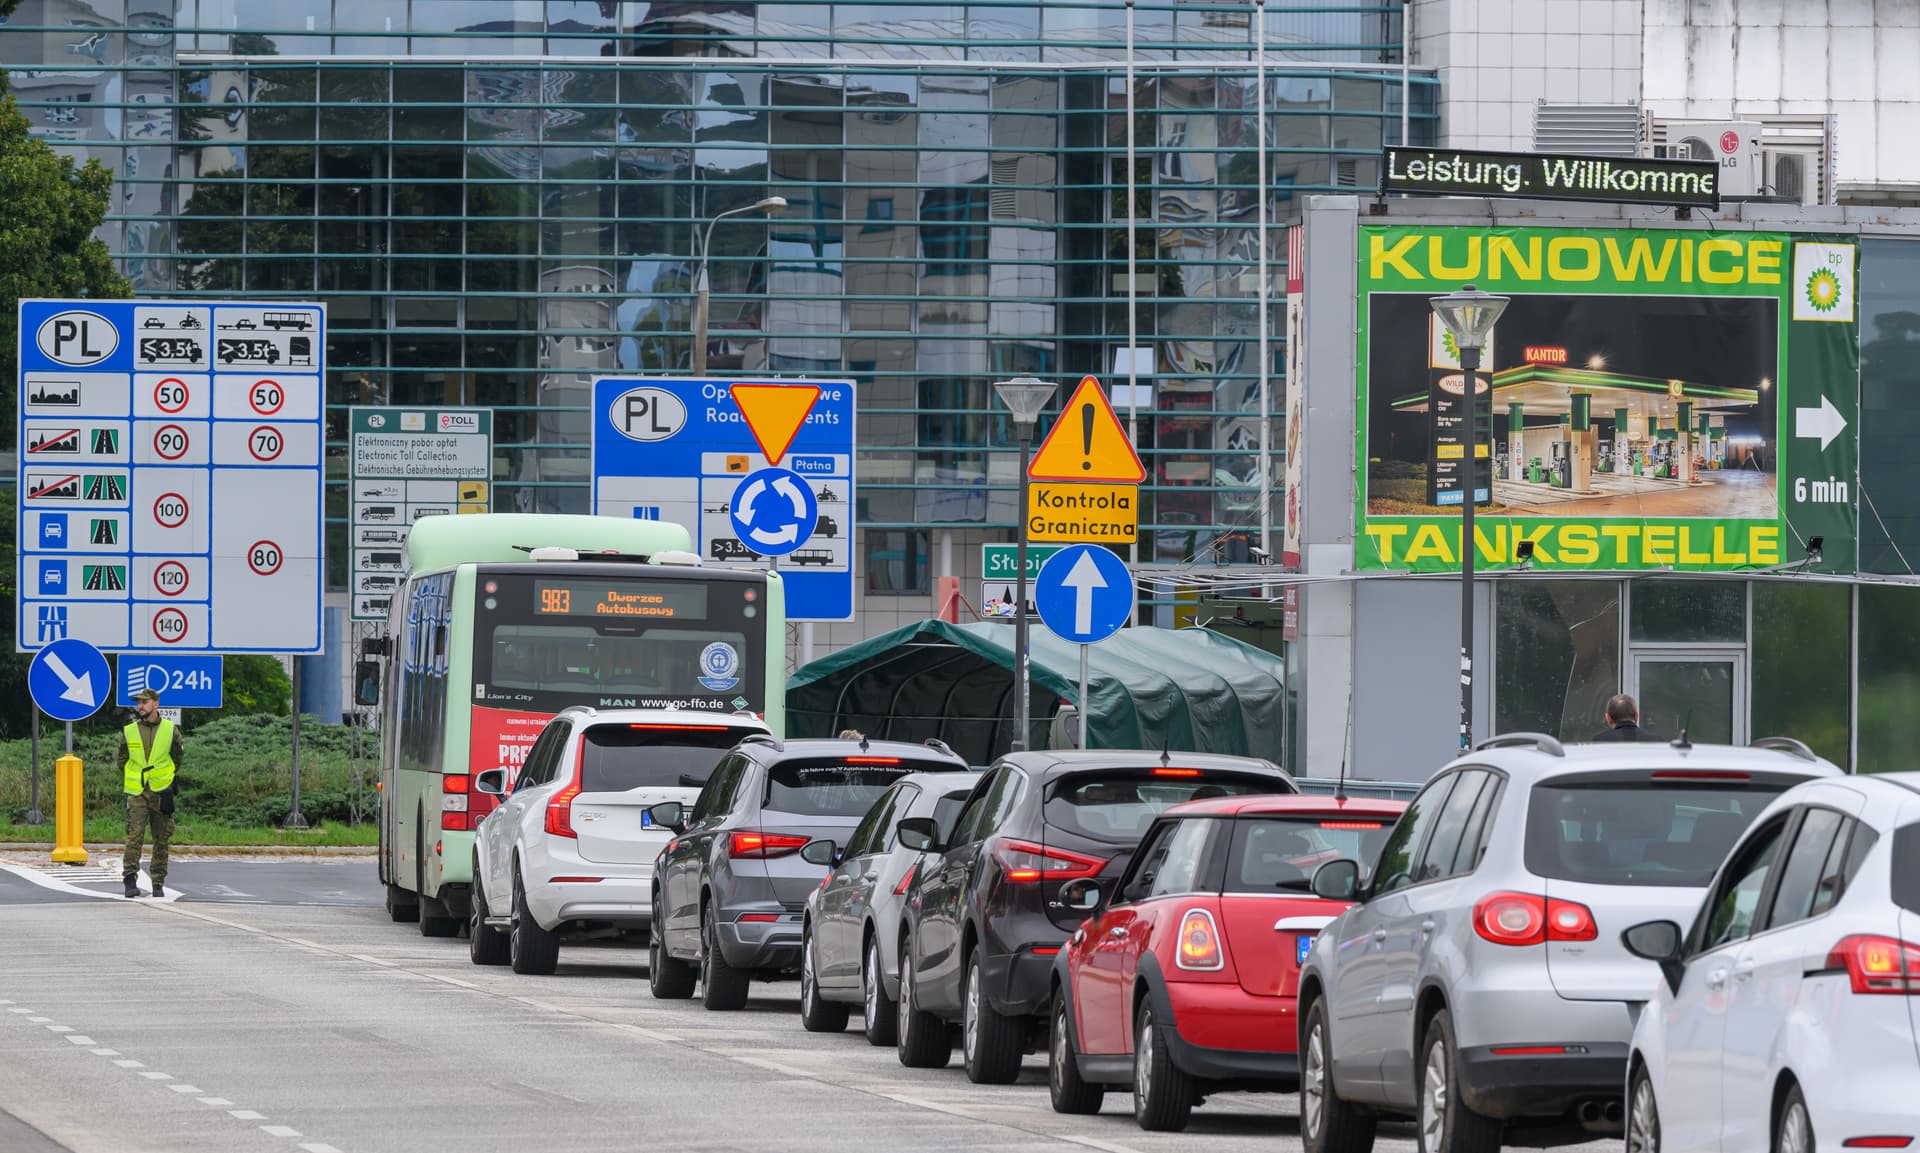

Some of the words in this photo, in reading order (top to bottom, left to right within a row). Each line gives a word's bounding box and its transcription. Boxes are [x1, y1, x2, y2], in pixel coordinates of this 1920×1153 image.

[1721, 156, 1737, 168] LG
[1388, 151, 1530, 193] Leistung.
[1368, 234, 1784, 285] KUNOWICE
[1828, 250, 1843, 266] bp
[54, 320, 102, 357] PL
[1525, 347, 1567, 362] KANTOR
[159, 387, 184, 404] 50
[255, 389, 280, 406] 50
[370, 416, 382, 426] PL
[624, 396, 672, 433] PL
[160, 434, 183, 451] 90
[256, 436, 278, 452] 70
[357, 436, 408, 449] Elektroniczny
[436, 438, 457, 450] opłat
[357, 449, 398, 461] Electronic
[400, 450, 413, 461] Toll
[416, 450, 457, 461] Collection
[357, 464, 404, 475] Elektronisches
[795, 460, 832, 471] Płatna
[1794, 478, 1806, 503] 6
[1811, 477, 1848, 503] min
[1037, 490, 1130, 509] Kontrola
[158, 502, 184, 517] 100
[1029, 516, 1135, 536] Graniczna
[1364, 524, 1779, 565] TANKSTELLE
[253, 550, 278, 567] 80
[160, 571, 184, 585] 120
[541, 589, 570, 613] 983
[607, 591, 664, 604] Dworzec
[596, 603, 674, 617] Autobusowy
[158, 617, 184, 633] 140
[172, 670, 212, 691] 24h
[487, 693, 512, 701] Lion's
[514, 693, 534, 702] City
[599, 697, 637, 708] MAN
[641, 697, 724, 711] www.go-ffo.de
